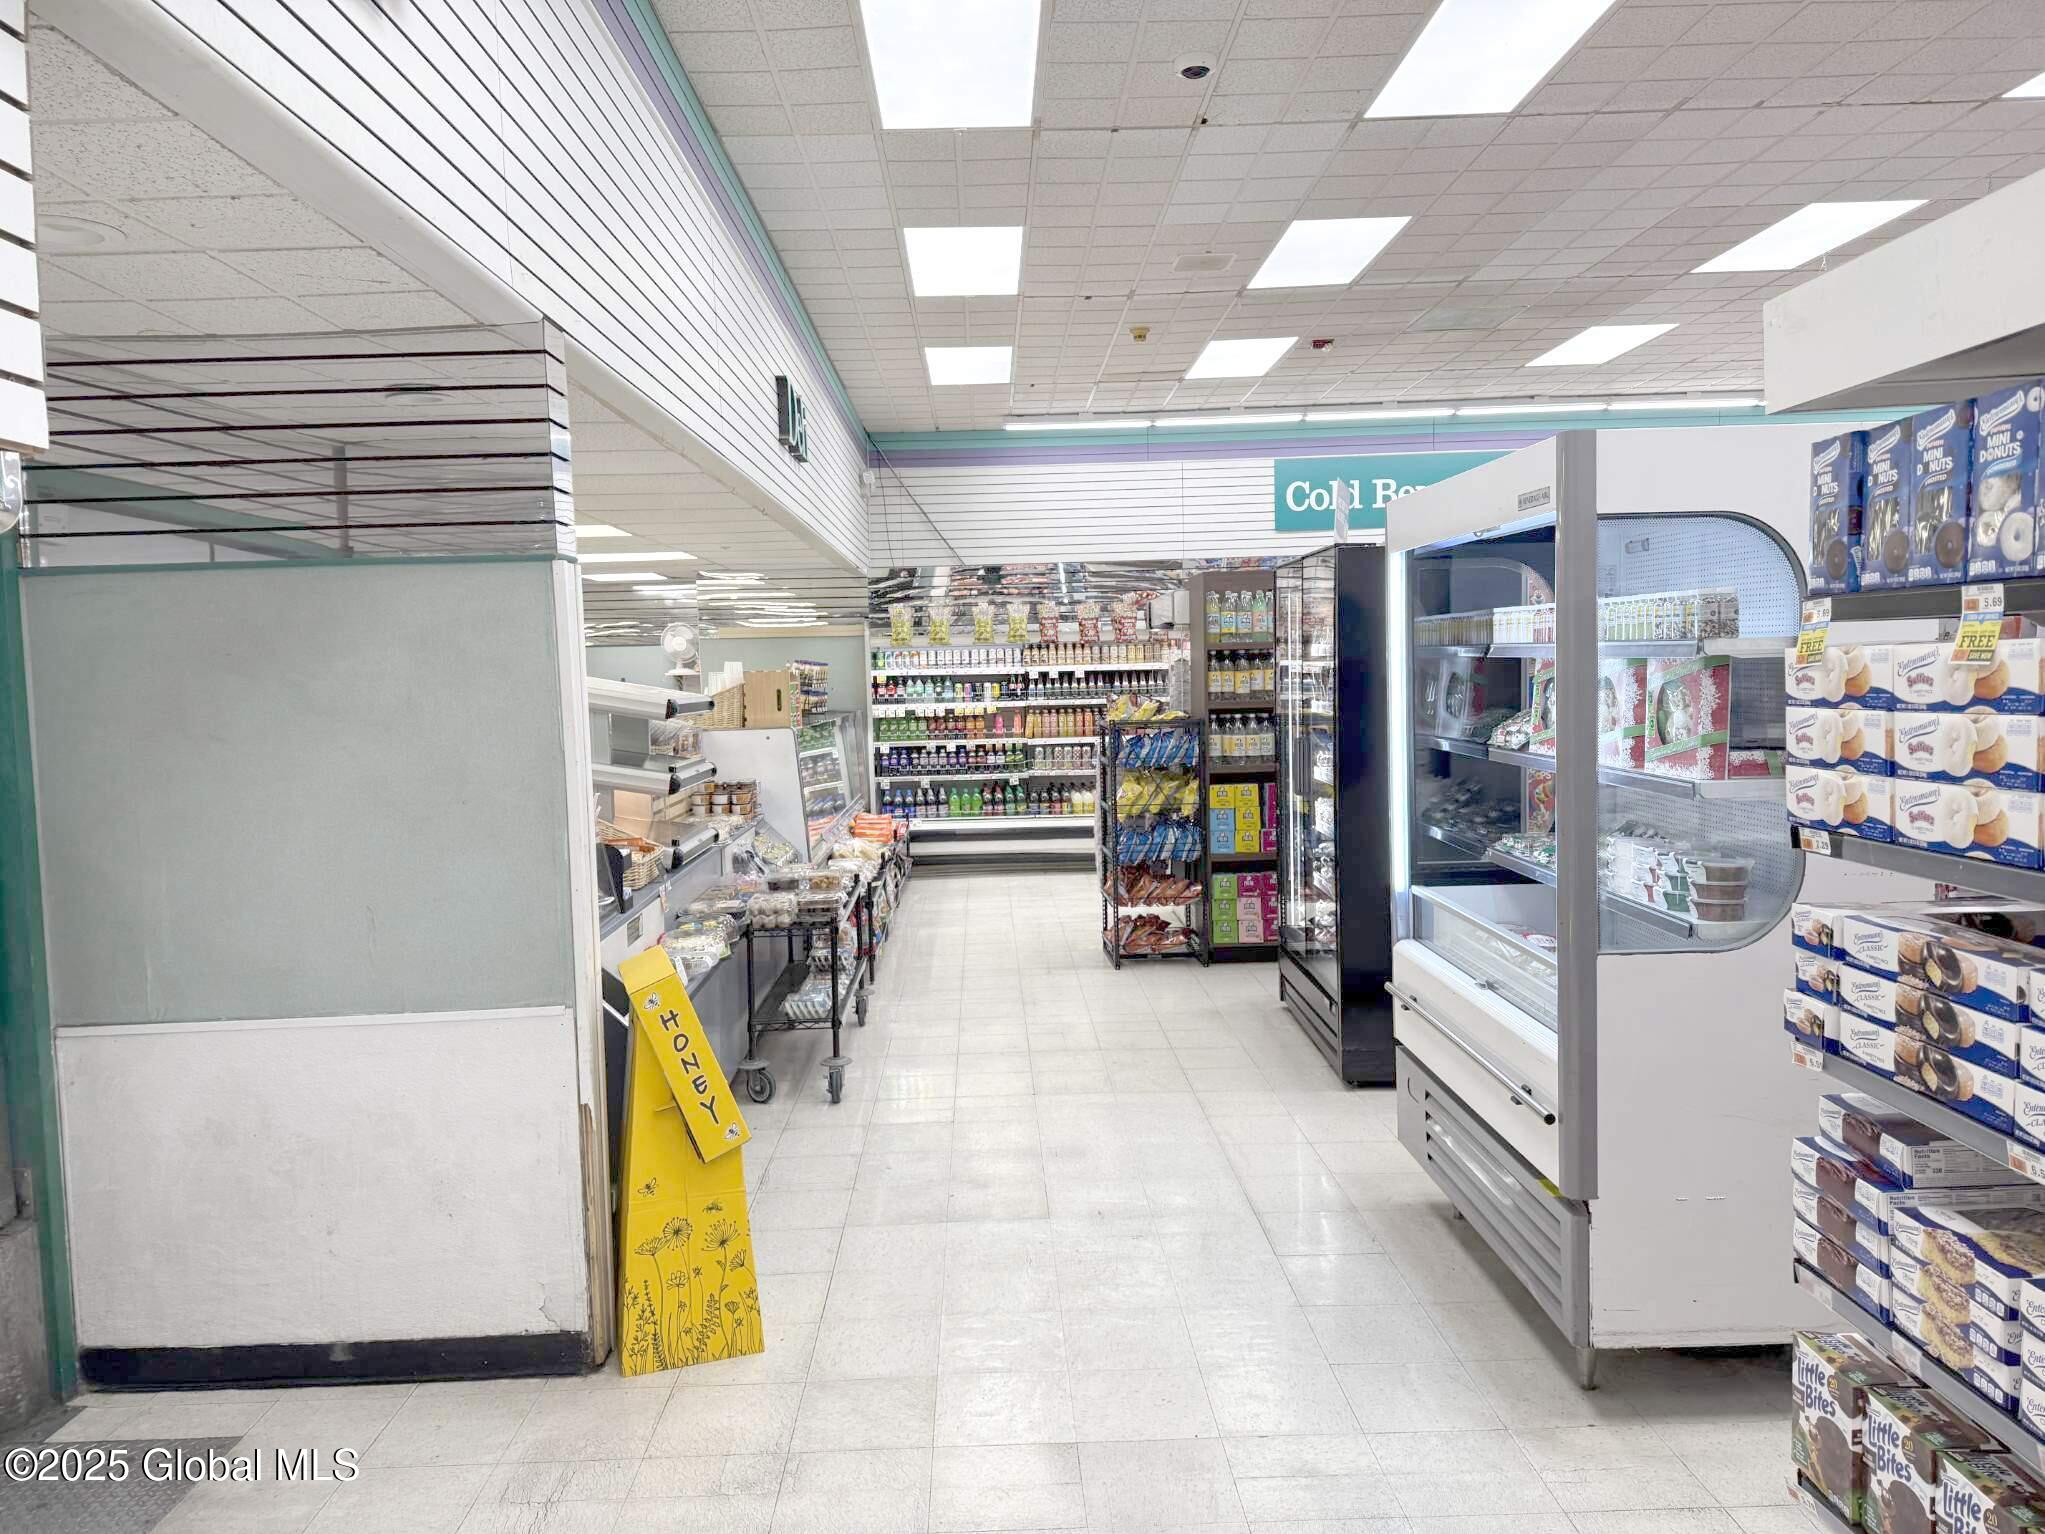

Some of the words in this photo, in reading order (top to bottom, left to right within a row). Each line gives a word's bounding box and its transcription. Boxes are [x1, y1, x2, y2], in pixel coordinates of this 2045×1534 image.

[1987, 431, 2011, 448] MINI
[1923, 447, 1943, 462] MINI
[1980, 442, 2021, 463] DONUTS
[1873, 460, 1890, 474] MINI
[1286, 478, 1362, 511] Cold
[1799, 640, 1823, 653] FREE
[1959, 635, 1996, 648] FREE
[1859, 945, 1885, 953] CLASSIC
[1856, 994, 1882, 1002] CLASSIC
[1855, 1042, 1880, 1050] CLASSIC
[660, 1009, 719, 1124] HONEY
[1798, 1357, 1825, 1388] Little
[1805, 1384, 1836, 1418] Bites
[1869, 1415, 1900, 1448] Little
[1904, 1440, 1914, 1452] 20
[1877, 1445, 1912, 1482] Bites
[1943, 1481, 1982, 1522] Little
[1986, 1512, 1998, 1527] 20
